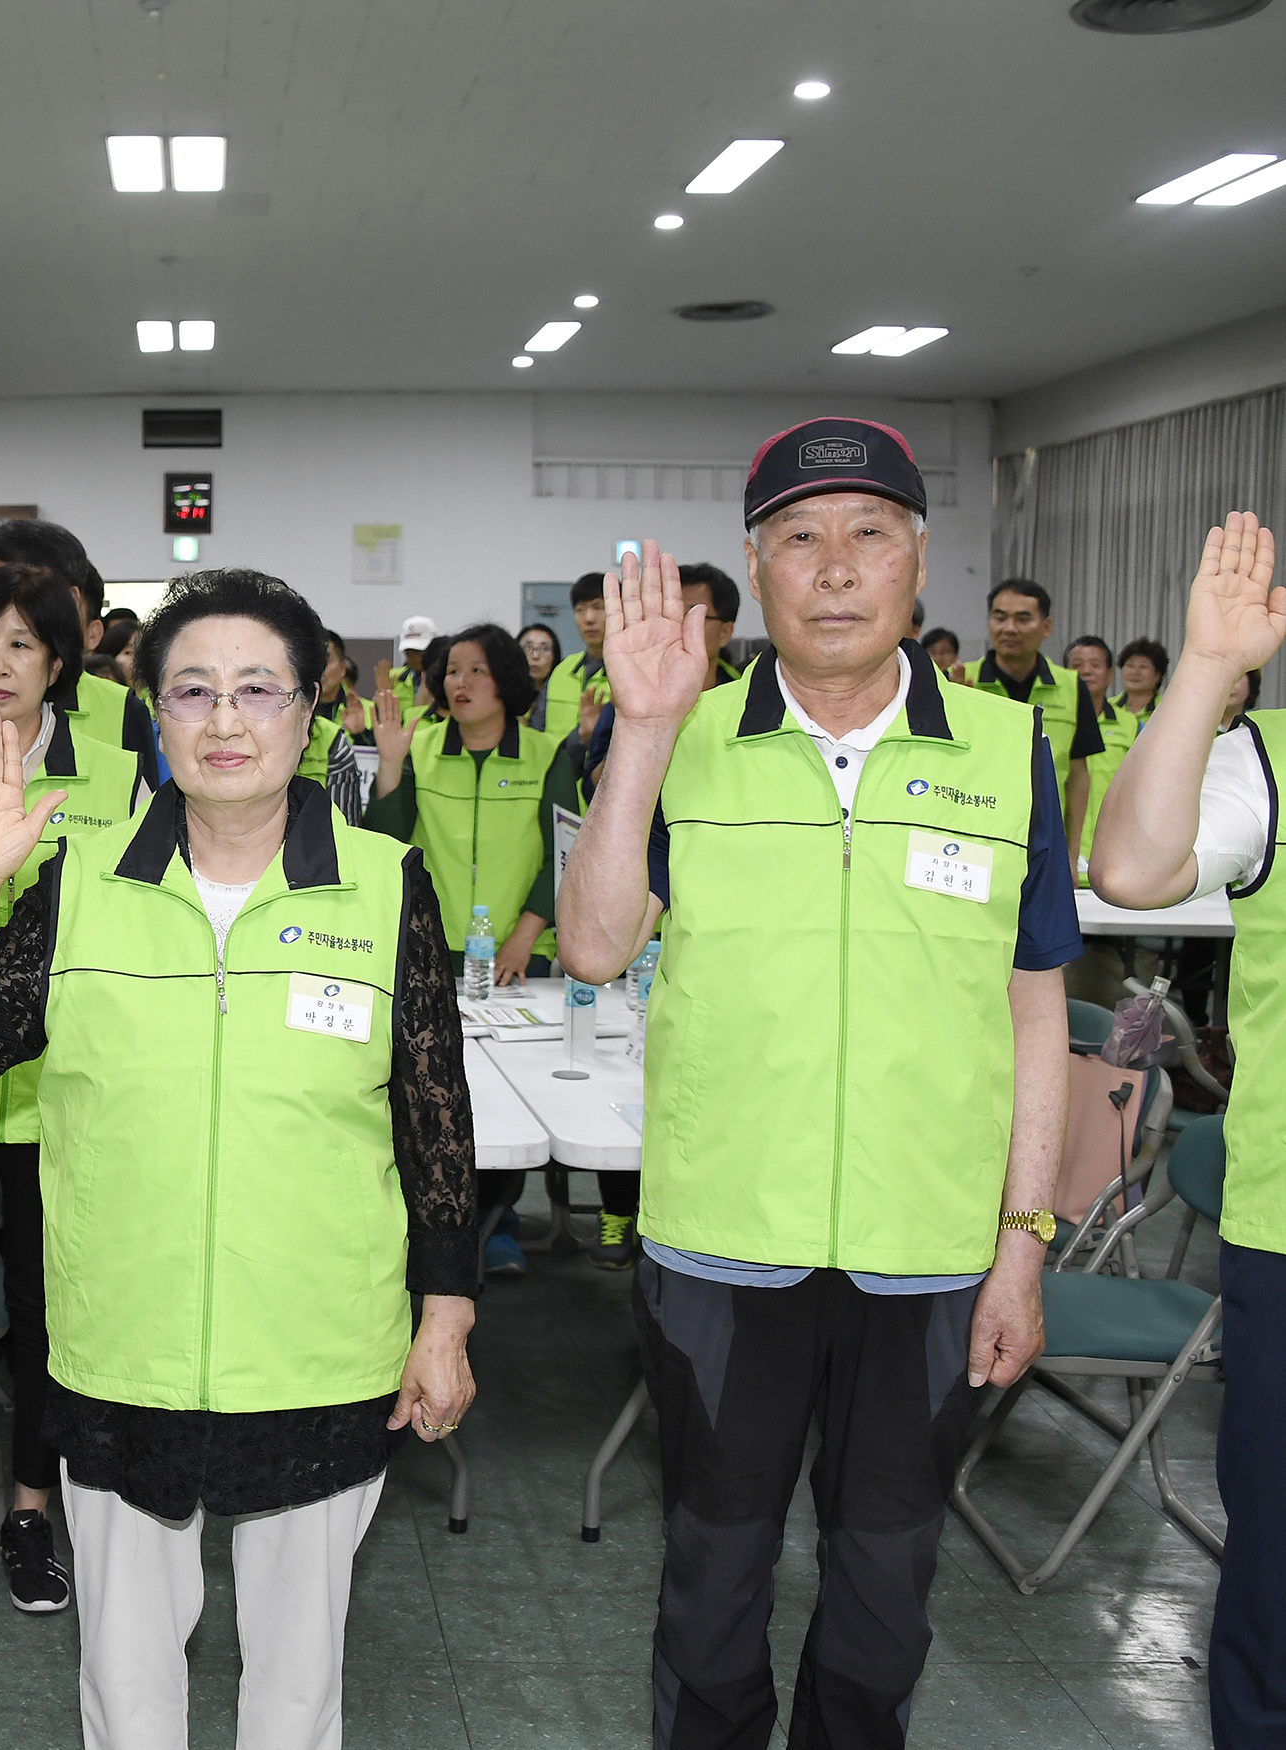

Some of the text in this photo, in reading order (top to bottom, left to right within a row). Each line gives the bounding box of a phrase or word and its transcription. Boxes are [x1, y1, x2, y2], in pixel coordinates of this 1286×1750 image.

[805, 444, 860, 460] Simon
[933, 785, 997, 809] 주민자율청소봉사단
[307, 930, 374, 954] 주민자율청소봉사단
